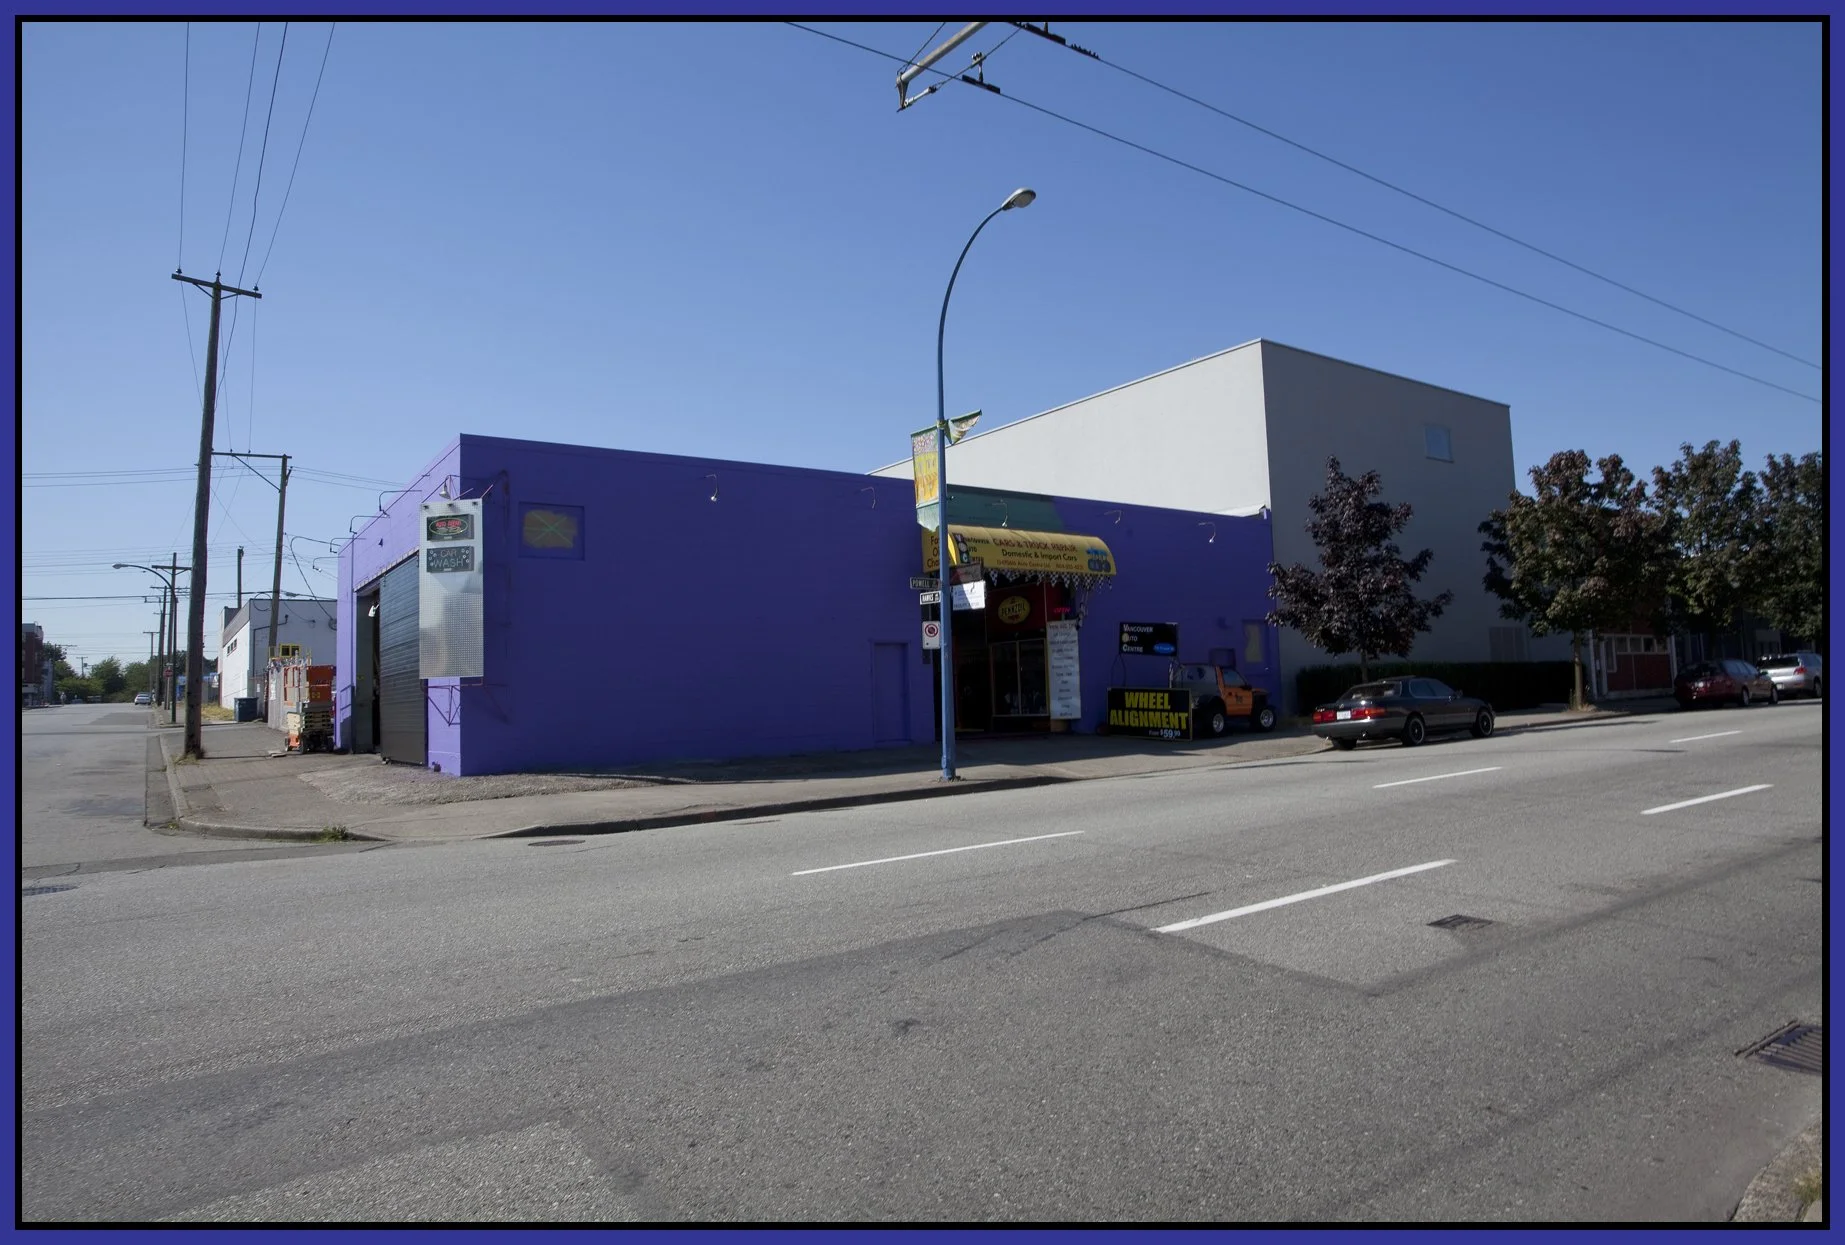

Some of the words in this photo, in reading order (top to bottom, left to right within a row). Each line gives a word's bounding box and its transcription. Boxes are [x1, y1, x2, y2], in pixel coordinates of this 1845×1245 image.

[1024, 541, 1049, 550] TRUCK
[440, 549, 457, 558] CAR
[1001, 549, 1032, 558] Domestic
[1040, 552, 1061, 561] Import
[1062, 553, 1077, 561] Cars
[433, 557, 464, 568] WASH
[912, 579, 930, 588] POWELL
[1001, 602, 1027, 617] PENNZOIL
[1123, 624, 1154, 633] VANCOUVER
[1122, 644, 1144, 653] CENTRE
[1125, 691, 1171, 709] WHEEL
[1109, 709, 1188, 730] ALIGNMENT
